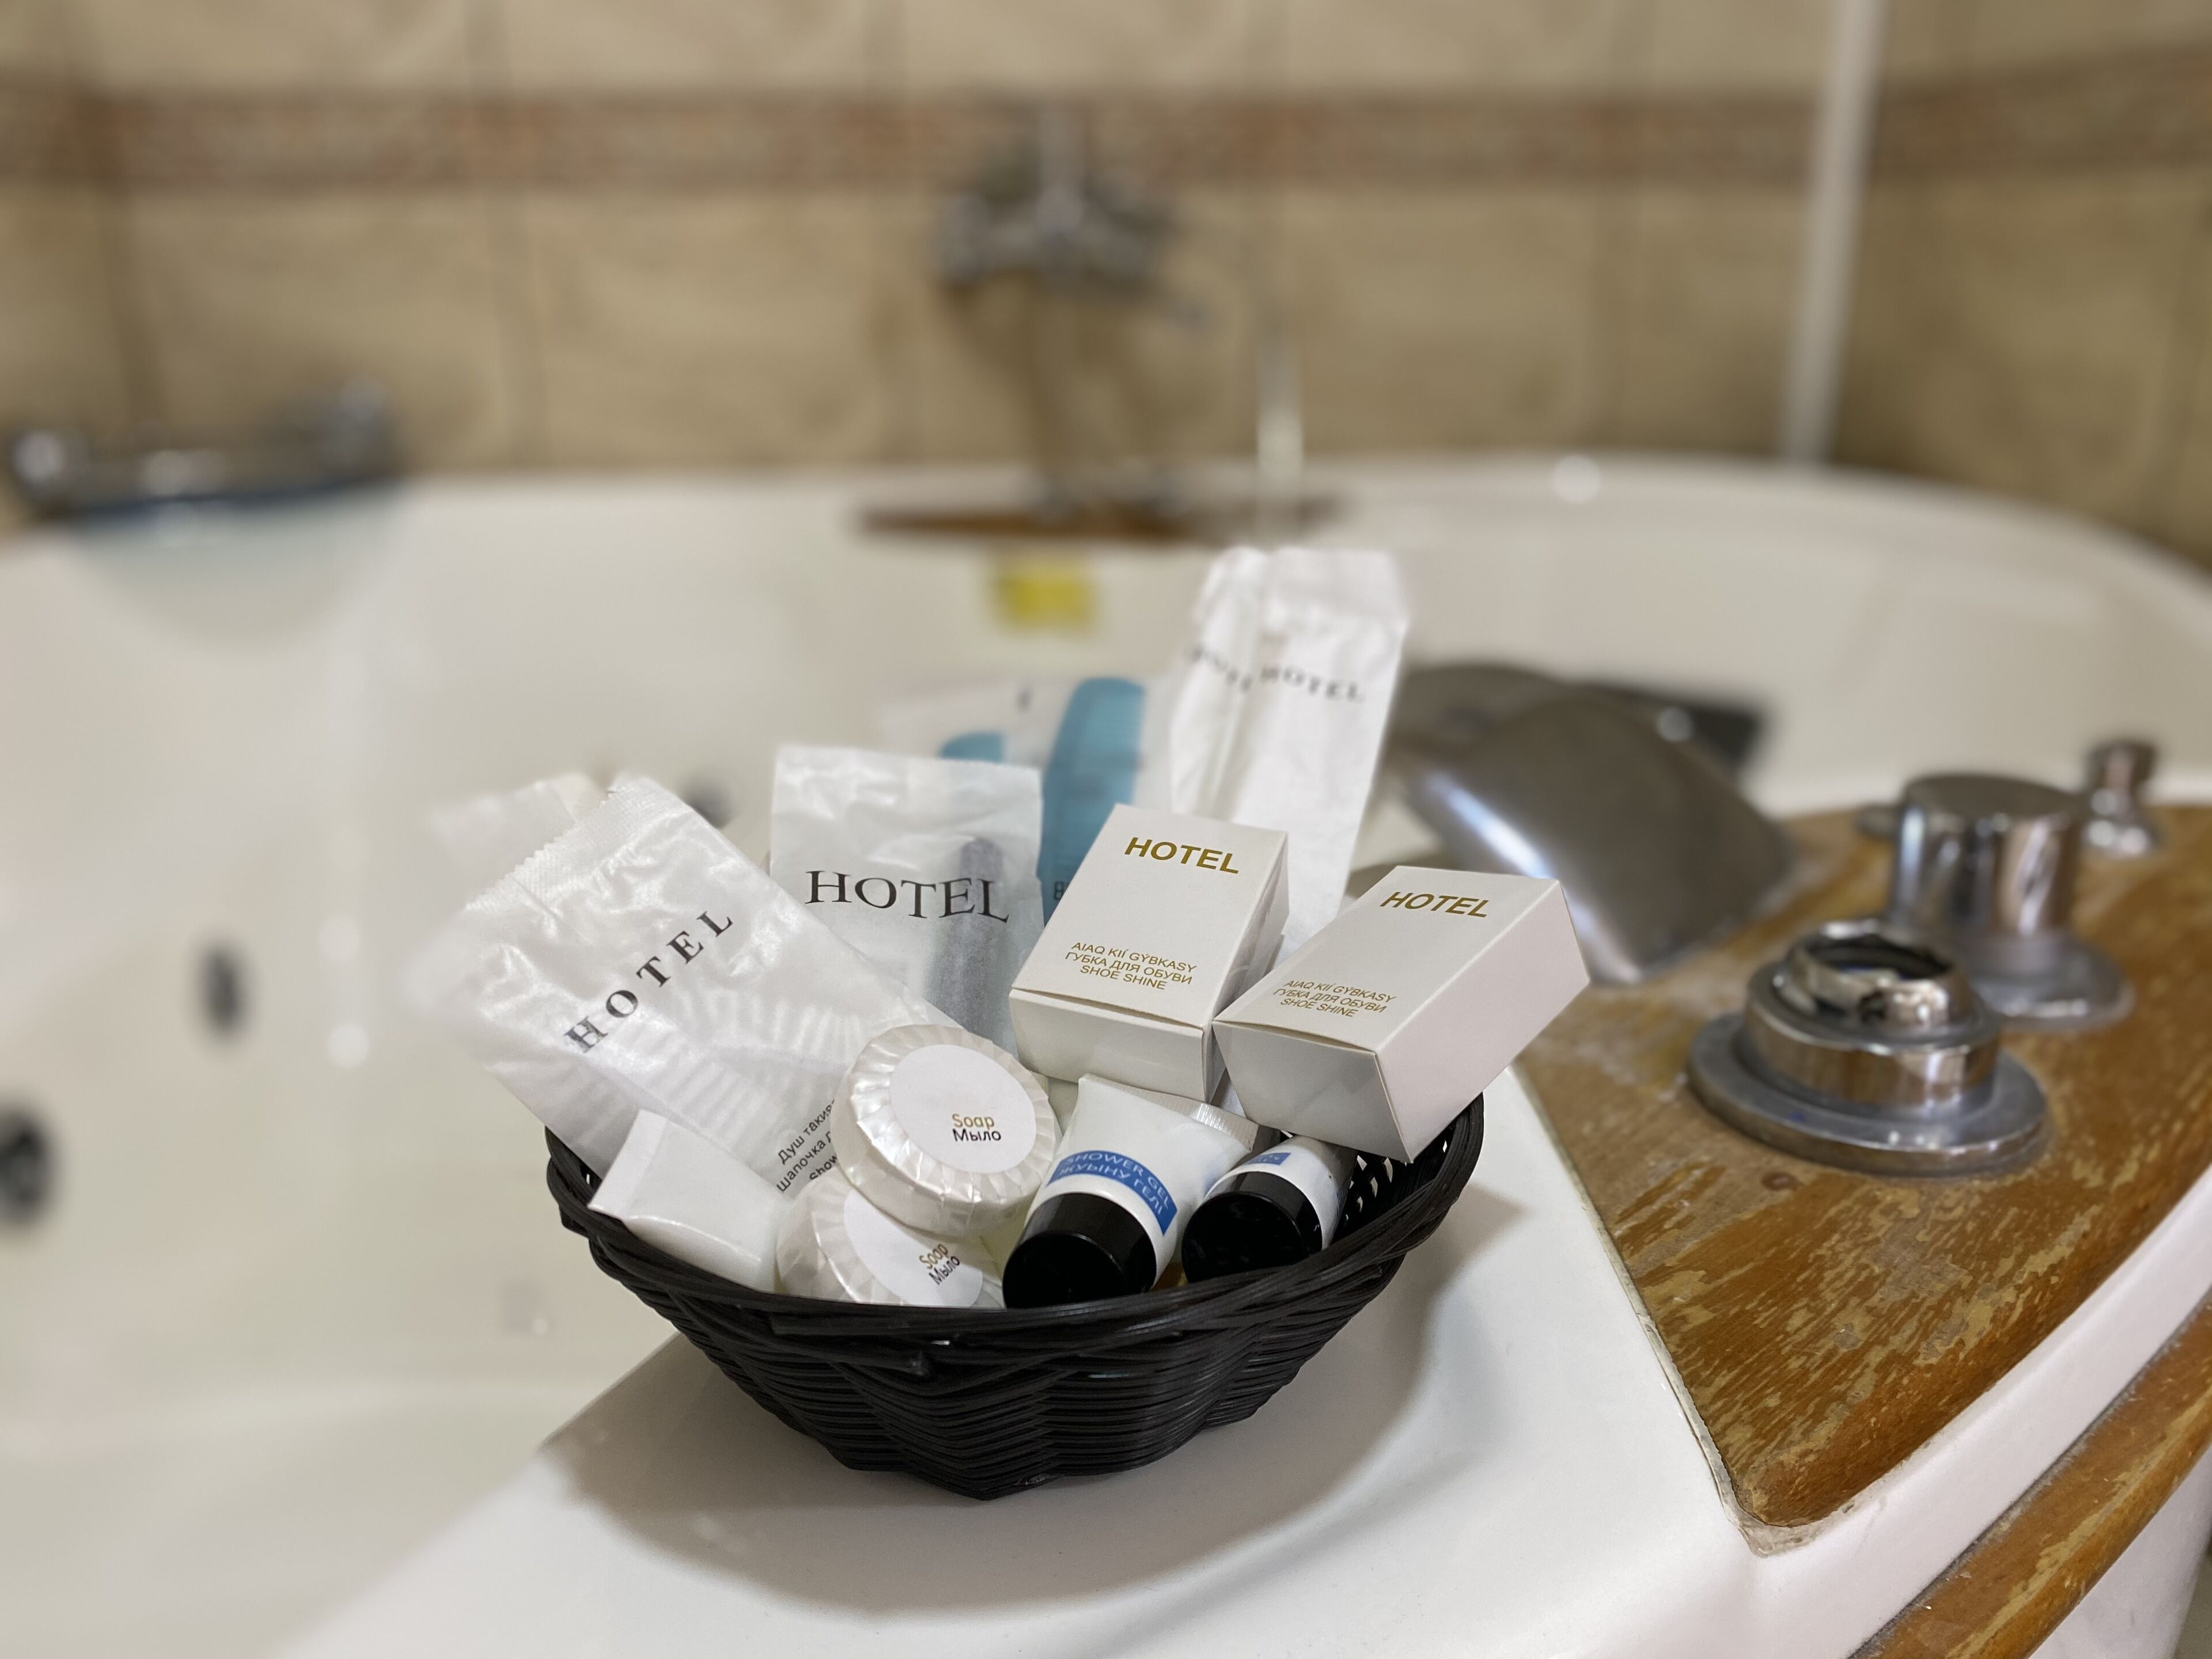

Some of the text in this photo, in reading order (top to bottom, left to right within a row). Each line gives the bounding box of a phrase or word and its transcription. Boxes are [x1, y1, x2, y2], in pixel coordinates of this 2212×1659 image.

[1124, 837, 1240, 874] HOTEL
[805, 870, 1010, 923] HOTEL
[1379, 891, 1490, 918] HOTEL
[1071, 942, 1105, 955] AIAQ
[1065, 952, 1193, 984] ГУБКА ДЛЯ ОБУВИ
[1080, 965, 1167, 990] SHOE SHINE
[563, 911, 733, 1054] HOTEL
[1283, 980, 1314, 989] AIAQ
[1273, 988, 1387, 1013] ГУБКА ДЛЯ ОБУВИ
[1281, 998, 1359, 1017] SHOE SHINE
[952, 1113, 995, 1130] Soap
[952, 1128, 1002, 1142] Мыло
[778, 1136, 805, 1165] Душ
[1066, 1152, 1169, 1210] SHOWER GEL
[919, 1244, 949, 1269] Soap
[929, 1256, 960, 1285] Мыло
